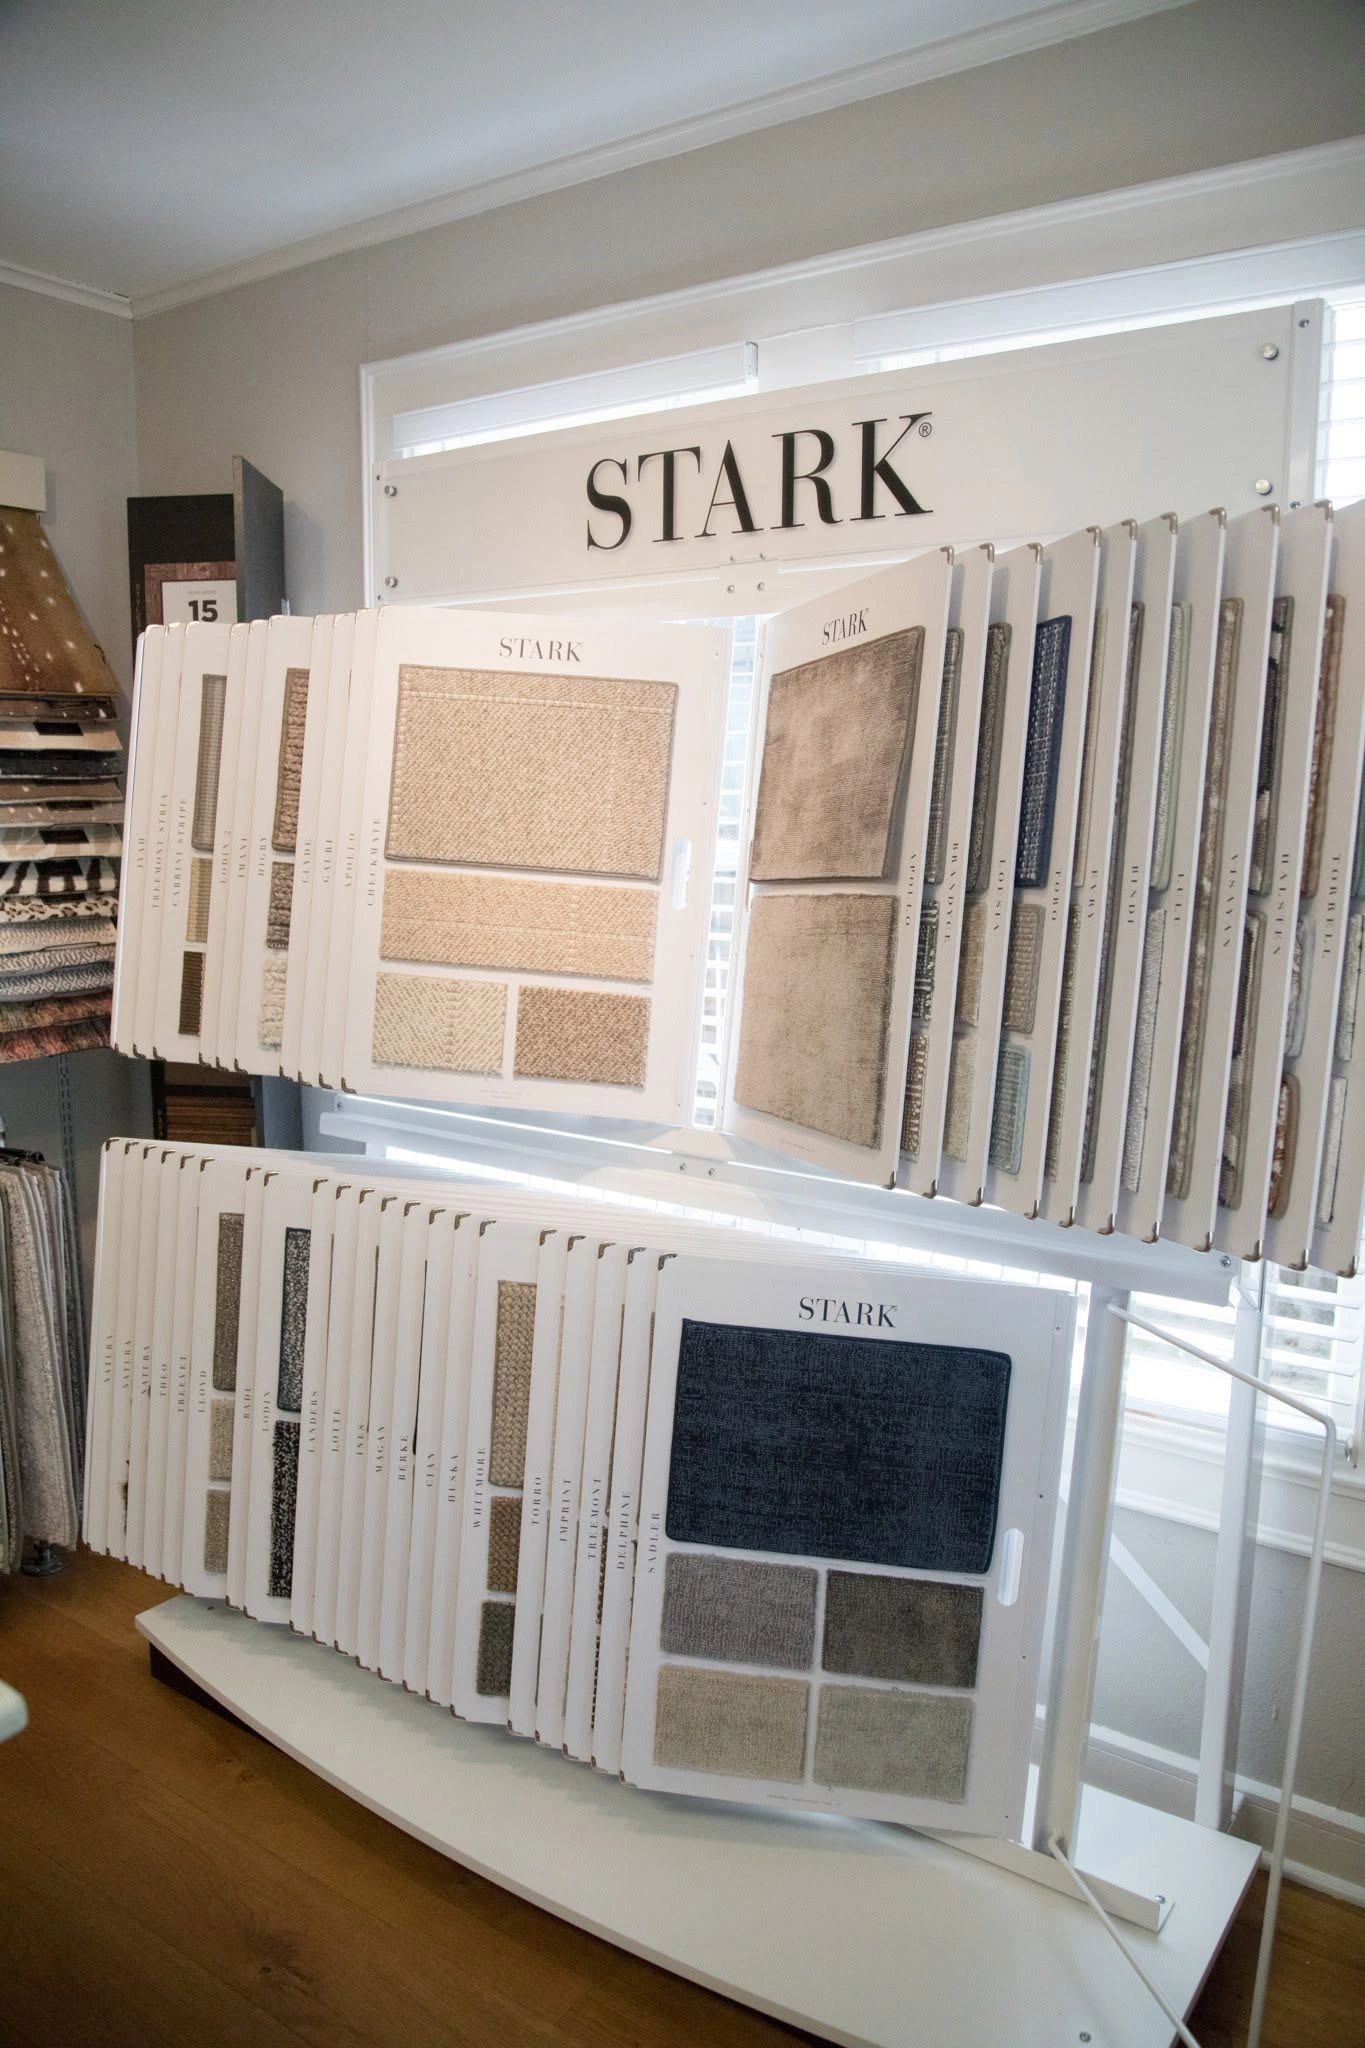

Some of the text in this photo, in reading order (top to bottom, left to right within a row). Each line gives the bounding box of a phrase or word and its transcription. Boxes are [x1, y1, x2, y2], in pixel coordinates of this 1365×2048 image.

[188, 600, 218, 623] 15
[822, 607, 870, 646] STARK
[499, 637, 583, 662] STARK
[344, 832, 356, 889] APOLLO
[367, 816, 381, 907] CHECKMATE
[905, 851, 917, 927] APOLLO
[944, 842, 959, 944] BRANDYCE
[1272, 853, 1290, 957] HALSTEN
[1322, 853, 1341, 960] TORRELL
[799, 1296, 898, 1329] STARK
[472, 1447, 486, 1529] WHITMORE
[530, 1476, 542, 1526] TORRO
[559, 1477, 572, 1543] IMPRINT
[587, 1477, 602, 1560] TREEMONT
[616, 1490, 631, 1570] DELPHINE
[647, 1512, 660, 1575] SADLER
